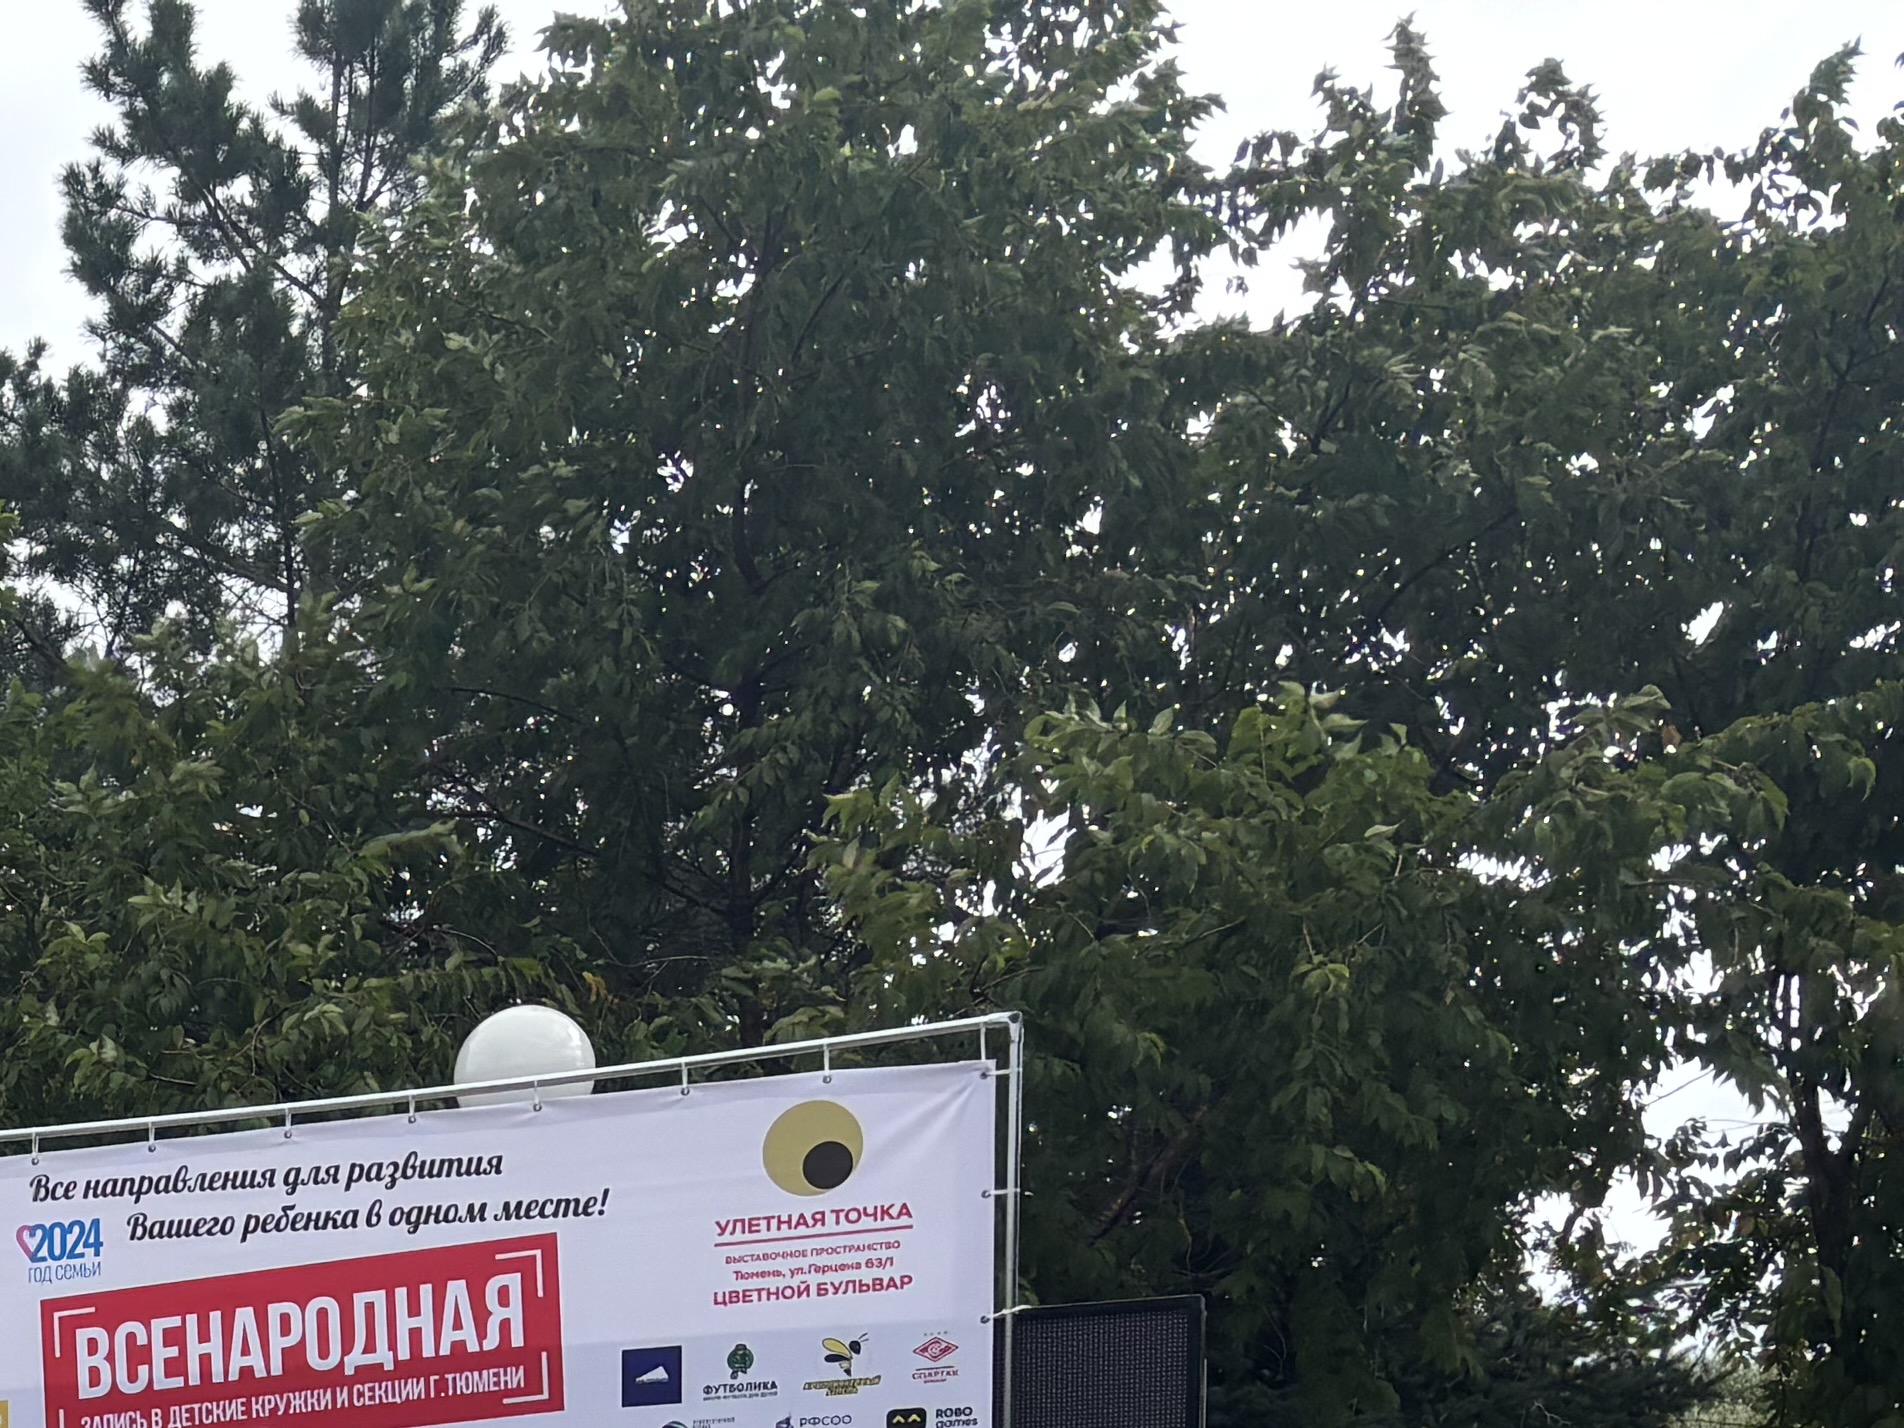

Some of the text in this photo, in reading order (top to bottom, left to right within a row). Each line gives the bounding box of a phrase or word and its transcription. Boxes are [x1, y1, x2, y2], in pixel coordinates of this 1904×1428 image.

[29, 1151, 503, 1204] Все направления для развития
[126, 1188, 610, 1243] Вашего ребенка в одном месте!
[714, 1202, 913, 1237] УЛЕТНАЯ ТОЧКА
[28, 1218, 104, 1263] 2024
[725, 1240, 901, 1265] ВЫСТАВОЧНОЕ ПРОСТРАНСТВО
[713, 1274, 913, 1307] ЦВЕТНОЙ БУЛЬВАР
[75, 1272, 525, 1400] ВСЕНАРОДНАЯ
[251, 1388, 332, 1418] КРУЖКИ
[336, 1385, 349, 1409] И
[352, 1376, 426, 1407] СЕКЦИИ
[703, 1380, 778, 1396] ФУТБОЛИКА
[935, 1406, 974, 1419] ROBO
